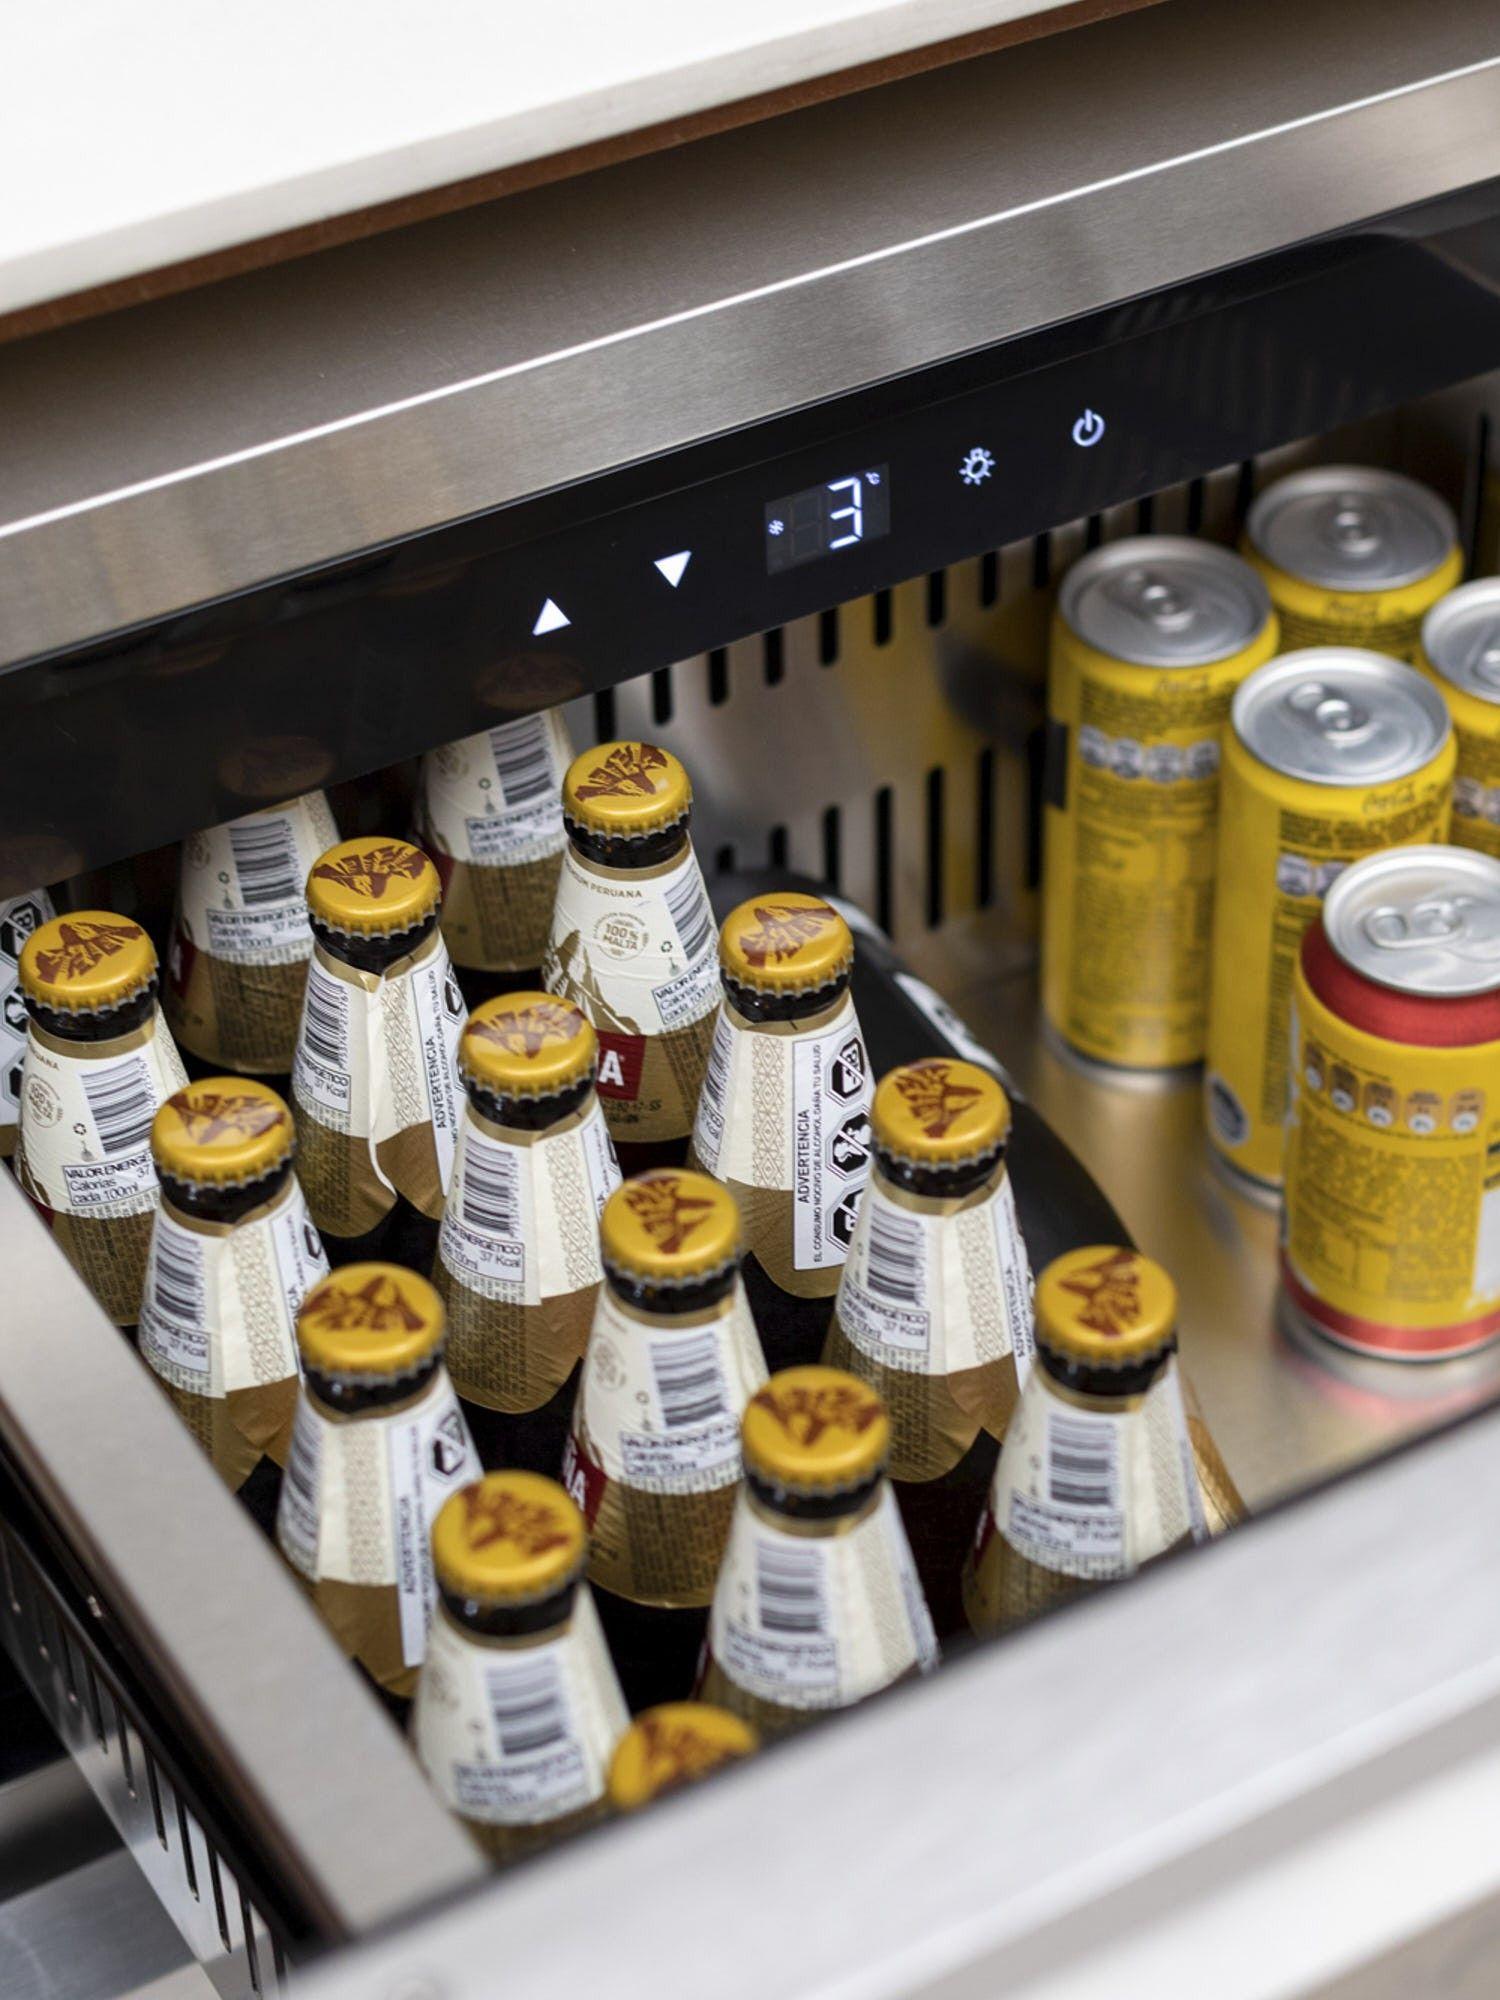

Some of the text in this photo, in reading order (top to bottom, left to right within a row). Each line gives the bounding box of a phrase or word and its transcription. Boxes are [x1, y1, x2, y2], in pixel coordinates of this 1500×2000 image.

[827, 477, 863, 549] 3
[590, 882, 643, 898] PERUANA
[602, 935, 638, 950] MALTA
[655, 977, 688, 999] VALOR
[812, 1044, 822, 1075] SALUD
[326, 1082, 347, 1098] Kcal
[425, 1036, 447, 1129] ADVERTENCIA
[812, 1076, 822, 1088] TU
[813, 1116, 823, 1158] ALCOHOL
[798, 1109, 810, 1204] ADVERTENCIA
[813, 1158, 823, 1171] DE
[64, 1165, 104, 1179] VALOR
[136, 1164, 150, 1179] 37
[73, 1181, 139, 1204] cada 100ml
[813, 1207, 823, 1250] CONSUMO
[479, 1249, 494, 1263] 37
[495, 1253, 521, 1269] Kcal
[813, 1251, 823, 1263] EL
[899, 1322, 925, 1337] Kcal
